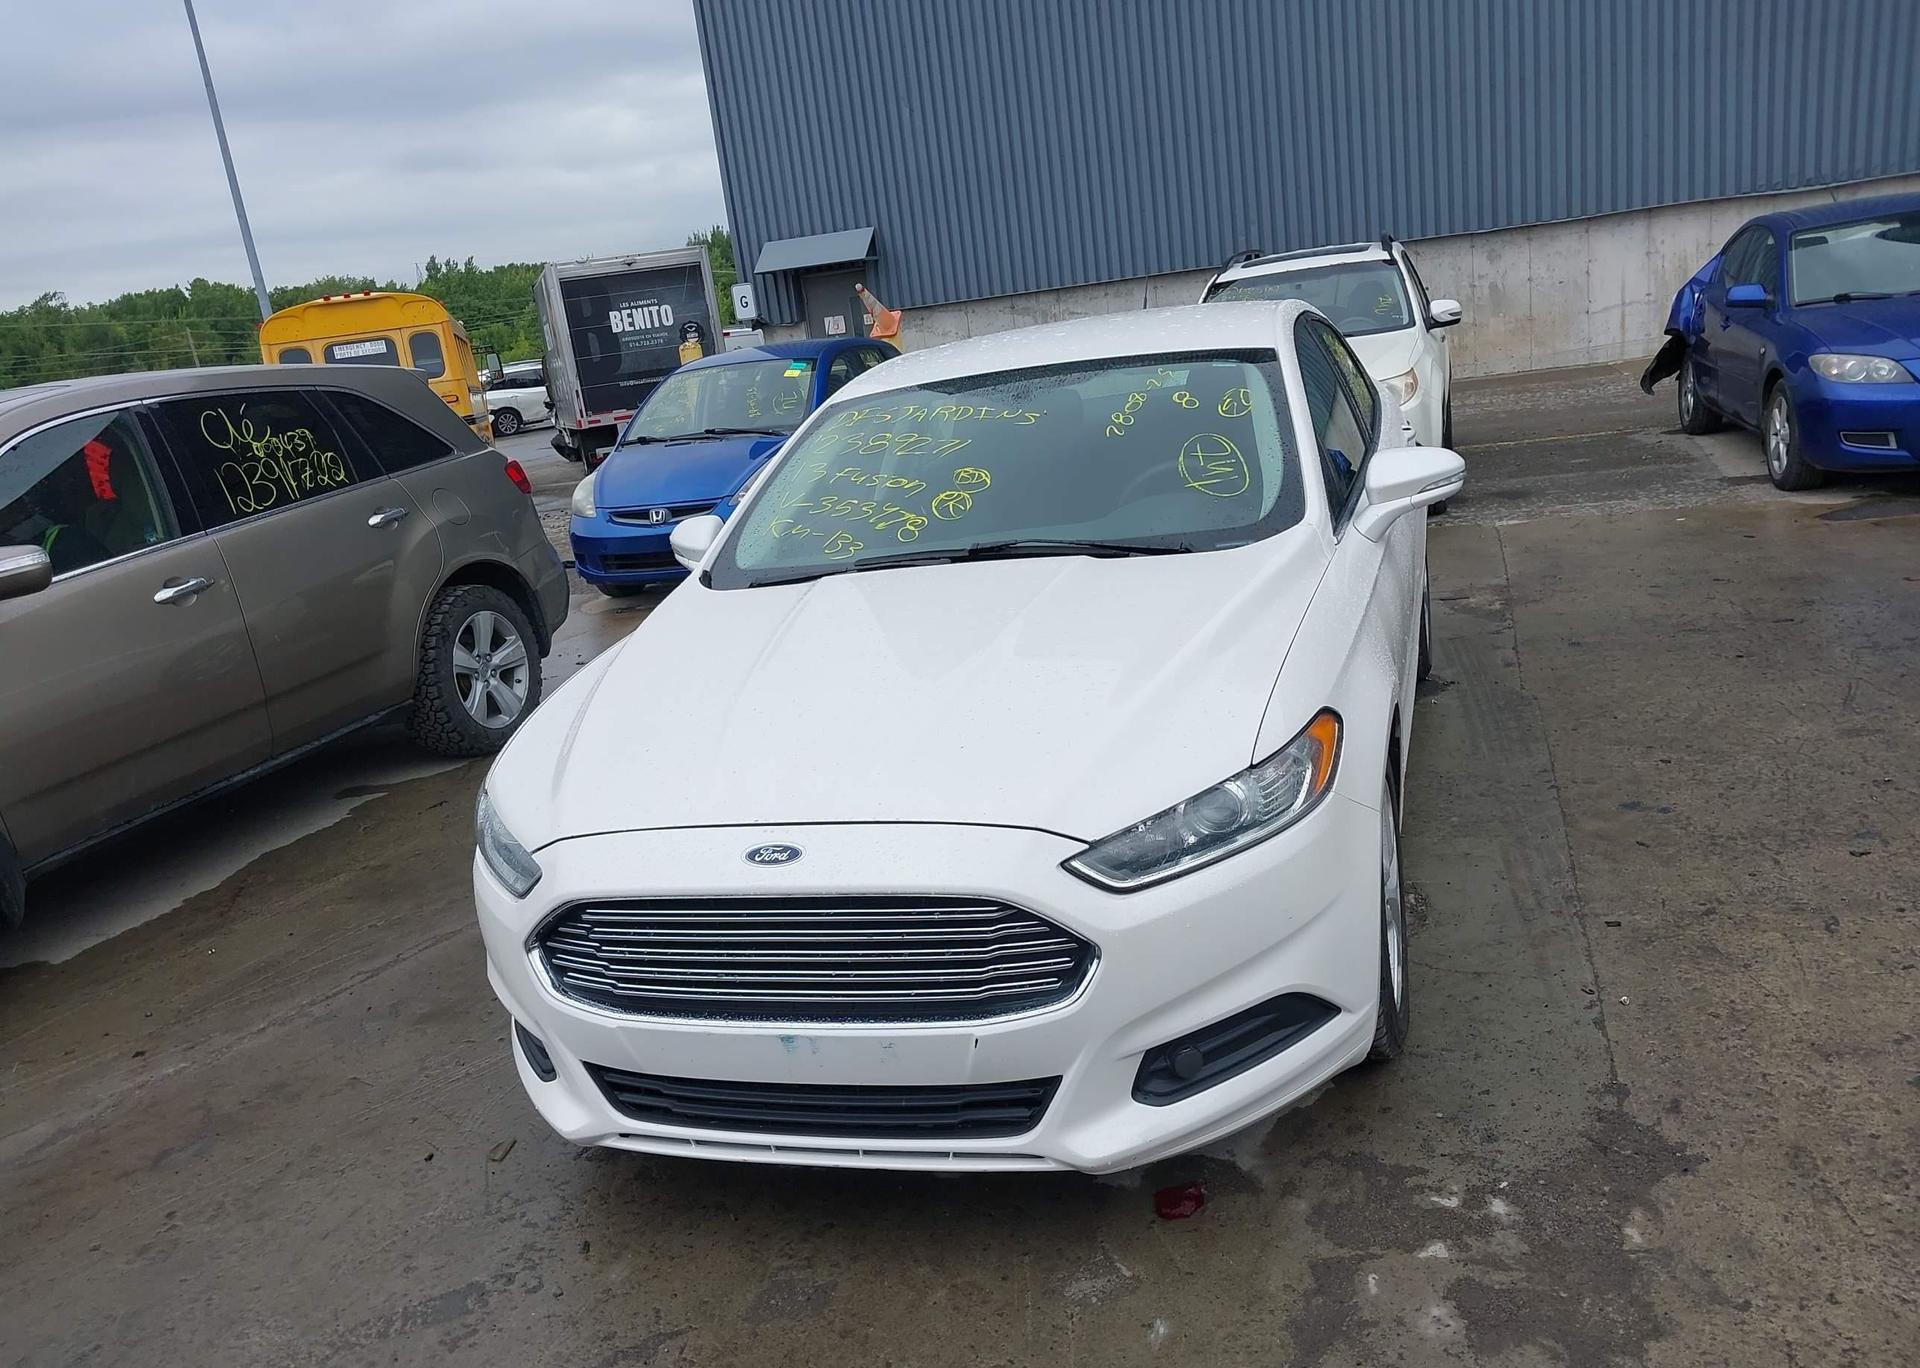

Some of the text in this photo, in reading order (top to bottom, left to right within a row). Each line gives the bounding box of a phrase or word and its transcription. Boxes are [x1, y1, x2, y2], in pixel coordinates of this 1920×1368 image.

[630, 298, 658, 307] ALIMENTS
[739, 295, 749, 309] G
[608, 304, 674, 333] BENITO
[754, 846, 792, 862] Ford
